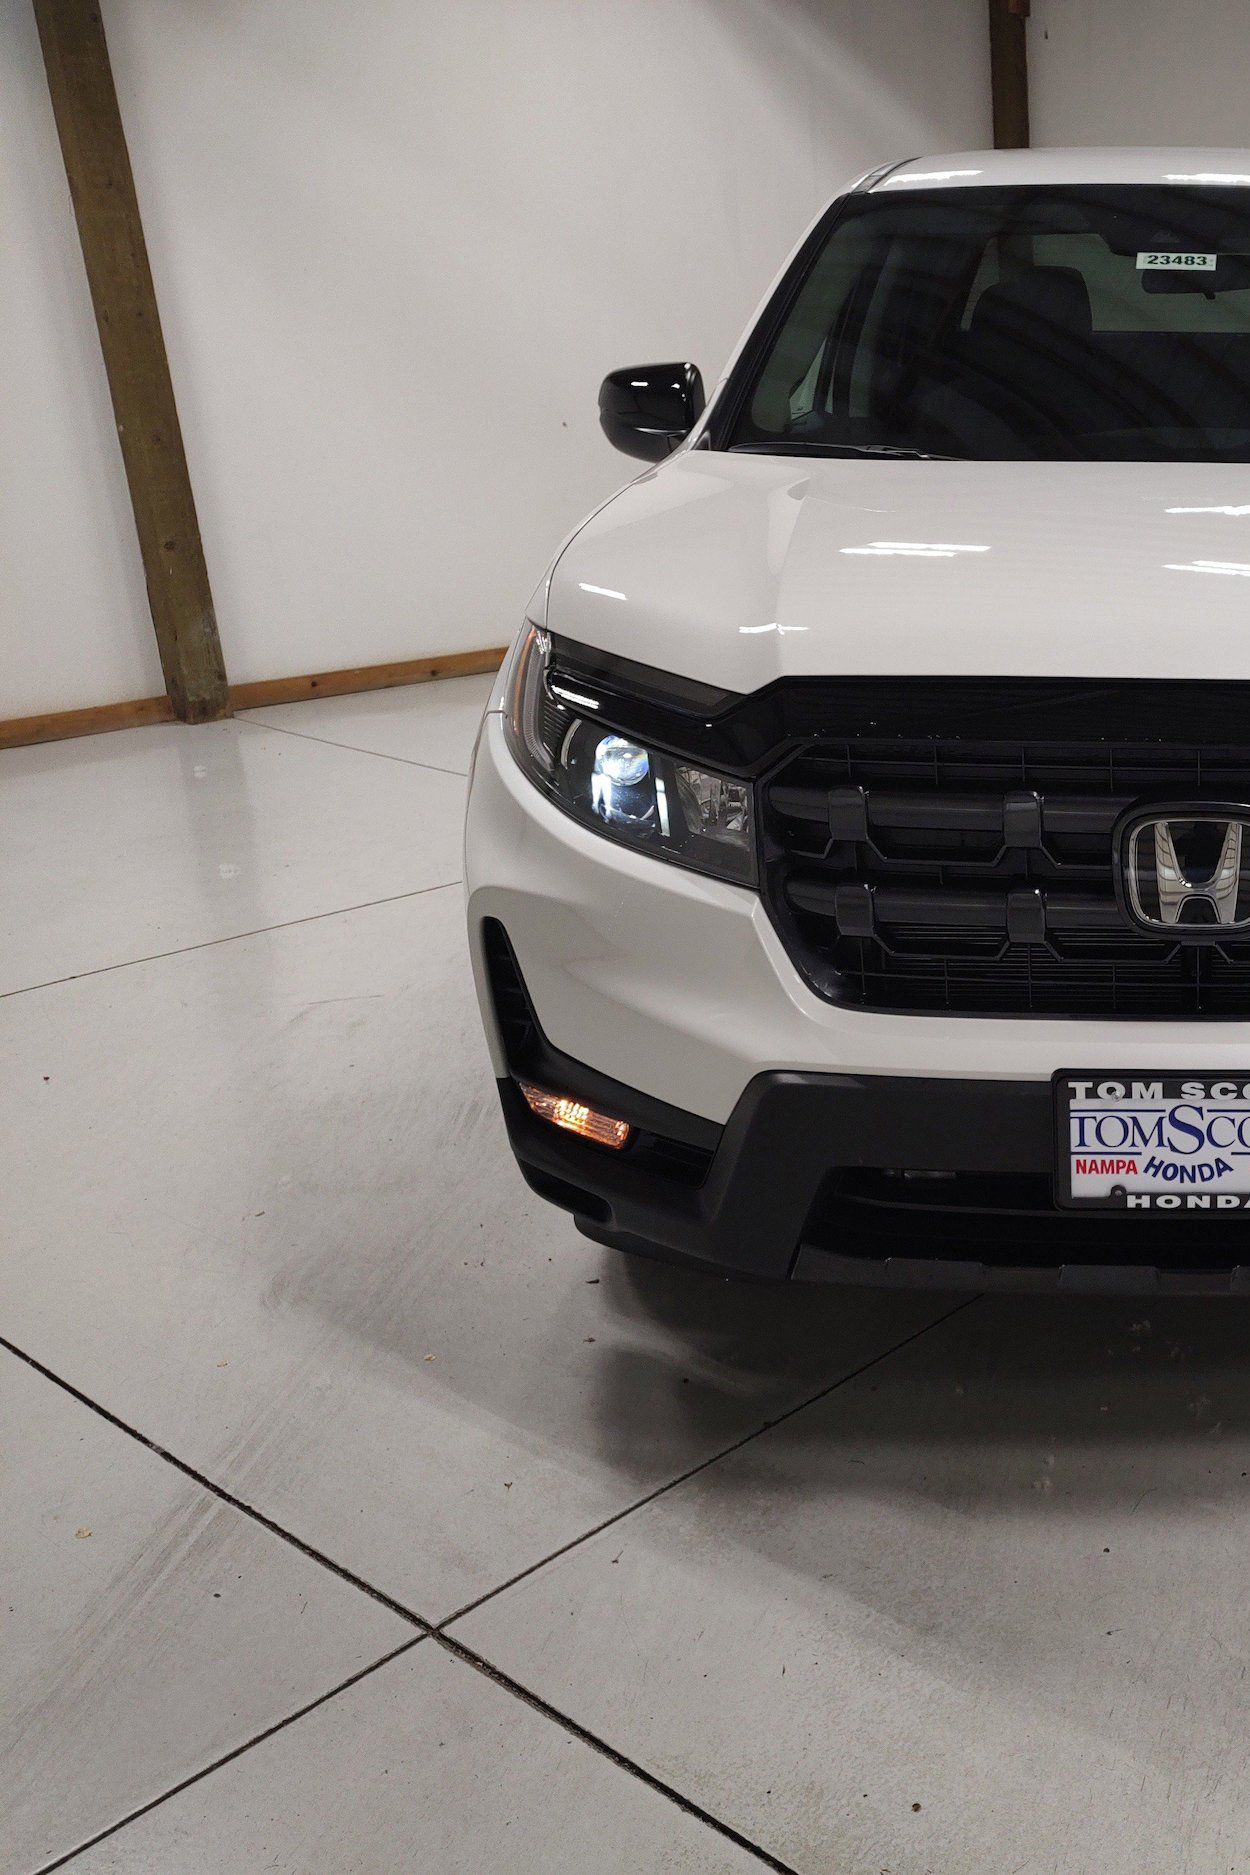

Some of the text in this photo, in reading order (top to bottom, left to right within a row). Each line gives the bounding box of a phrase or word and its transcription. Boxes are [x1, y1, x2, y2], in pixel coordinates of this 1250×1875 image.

[1147, 255, 1207, 266] 23483
[1068, 1081, 1164, 1100] TOM
[1075, 1159, 1138, 1175] NAMPA
[1143, 1156, 1234, 1184] HONDA
